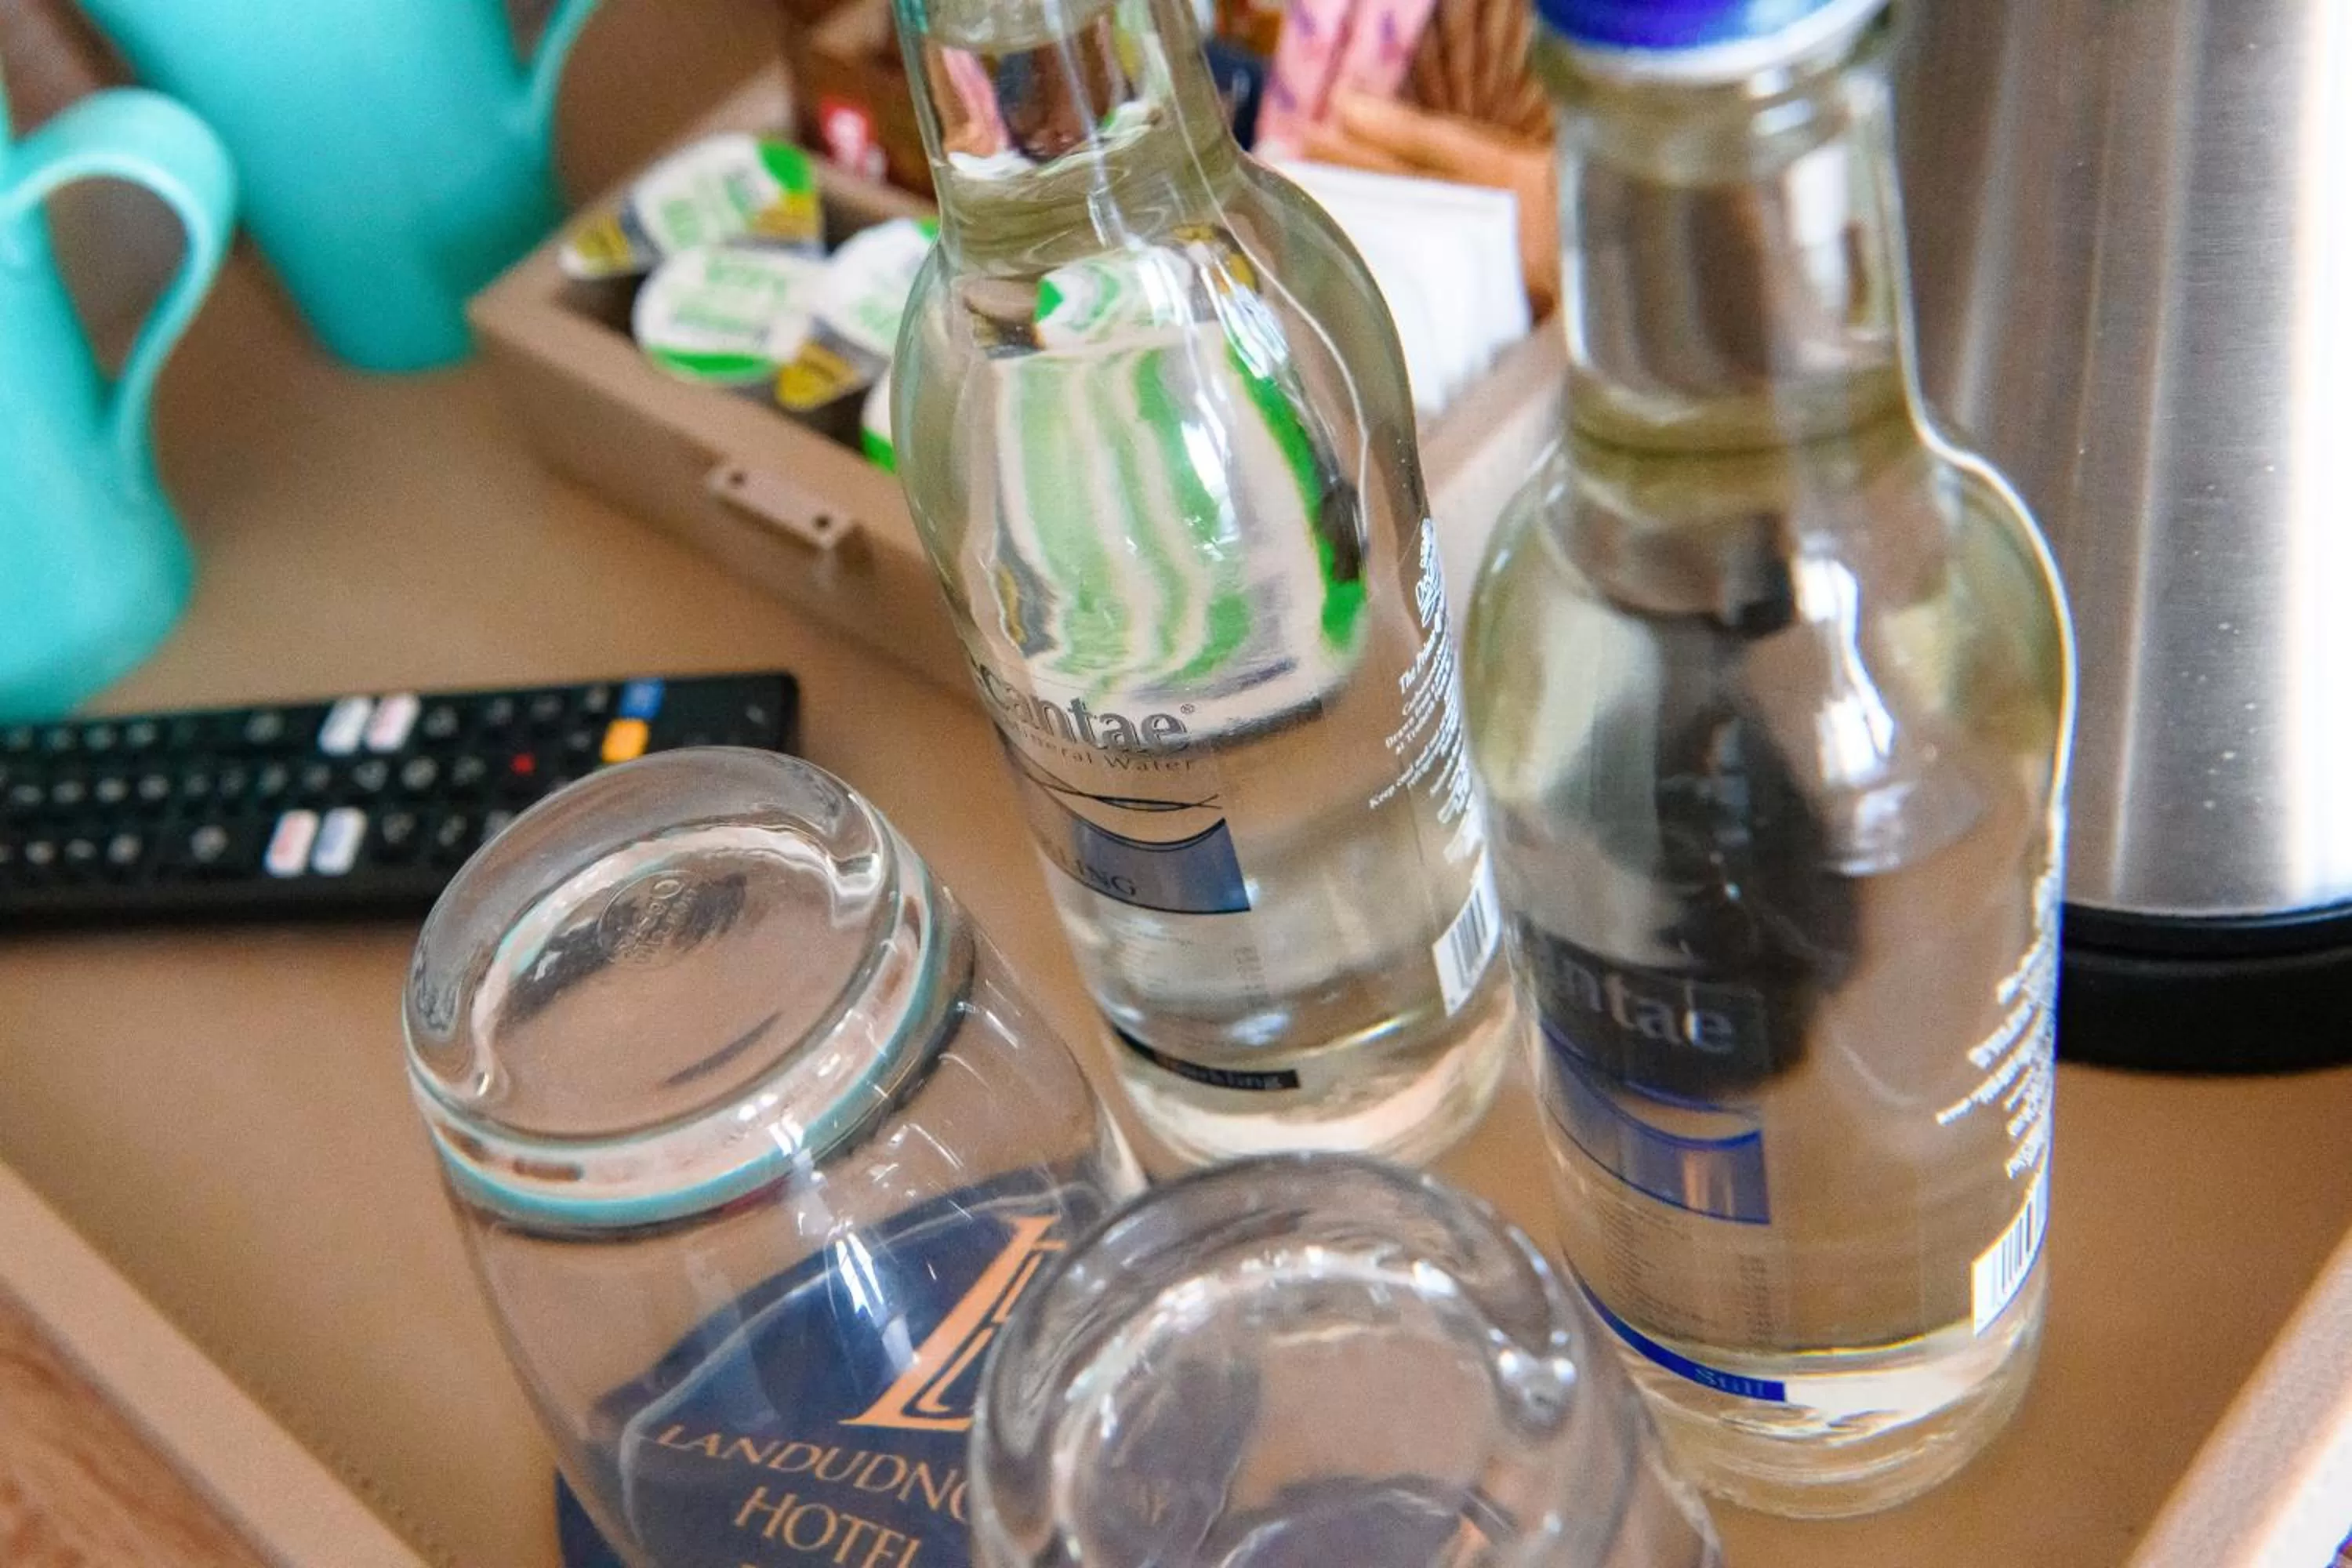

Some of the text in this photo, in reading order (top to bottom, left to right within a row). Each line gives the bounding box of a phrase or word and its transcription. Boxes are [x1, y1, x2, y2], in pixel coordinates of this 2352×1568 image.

[1103, 753, 1191, 771] Water
[1563, 955, 1736, 1054] ntae
[1694, 1368, 1765, 1397] Still
